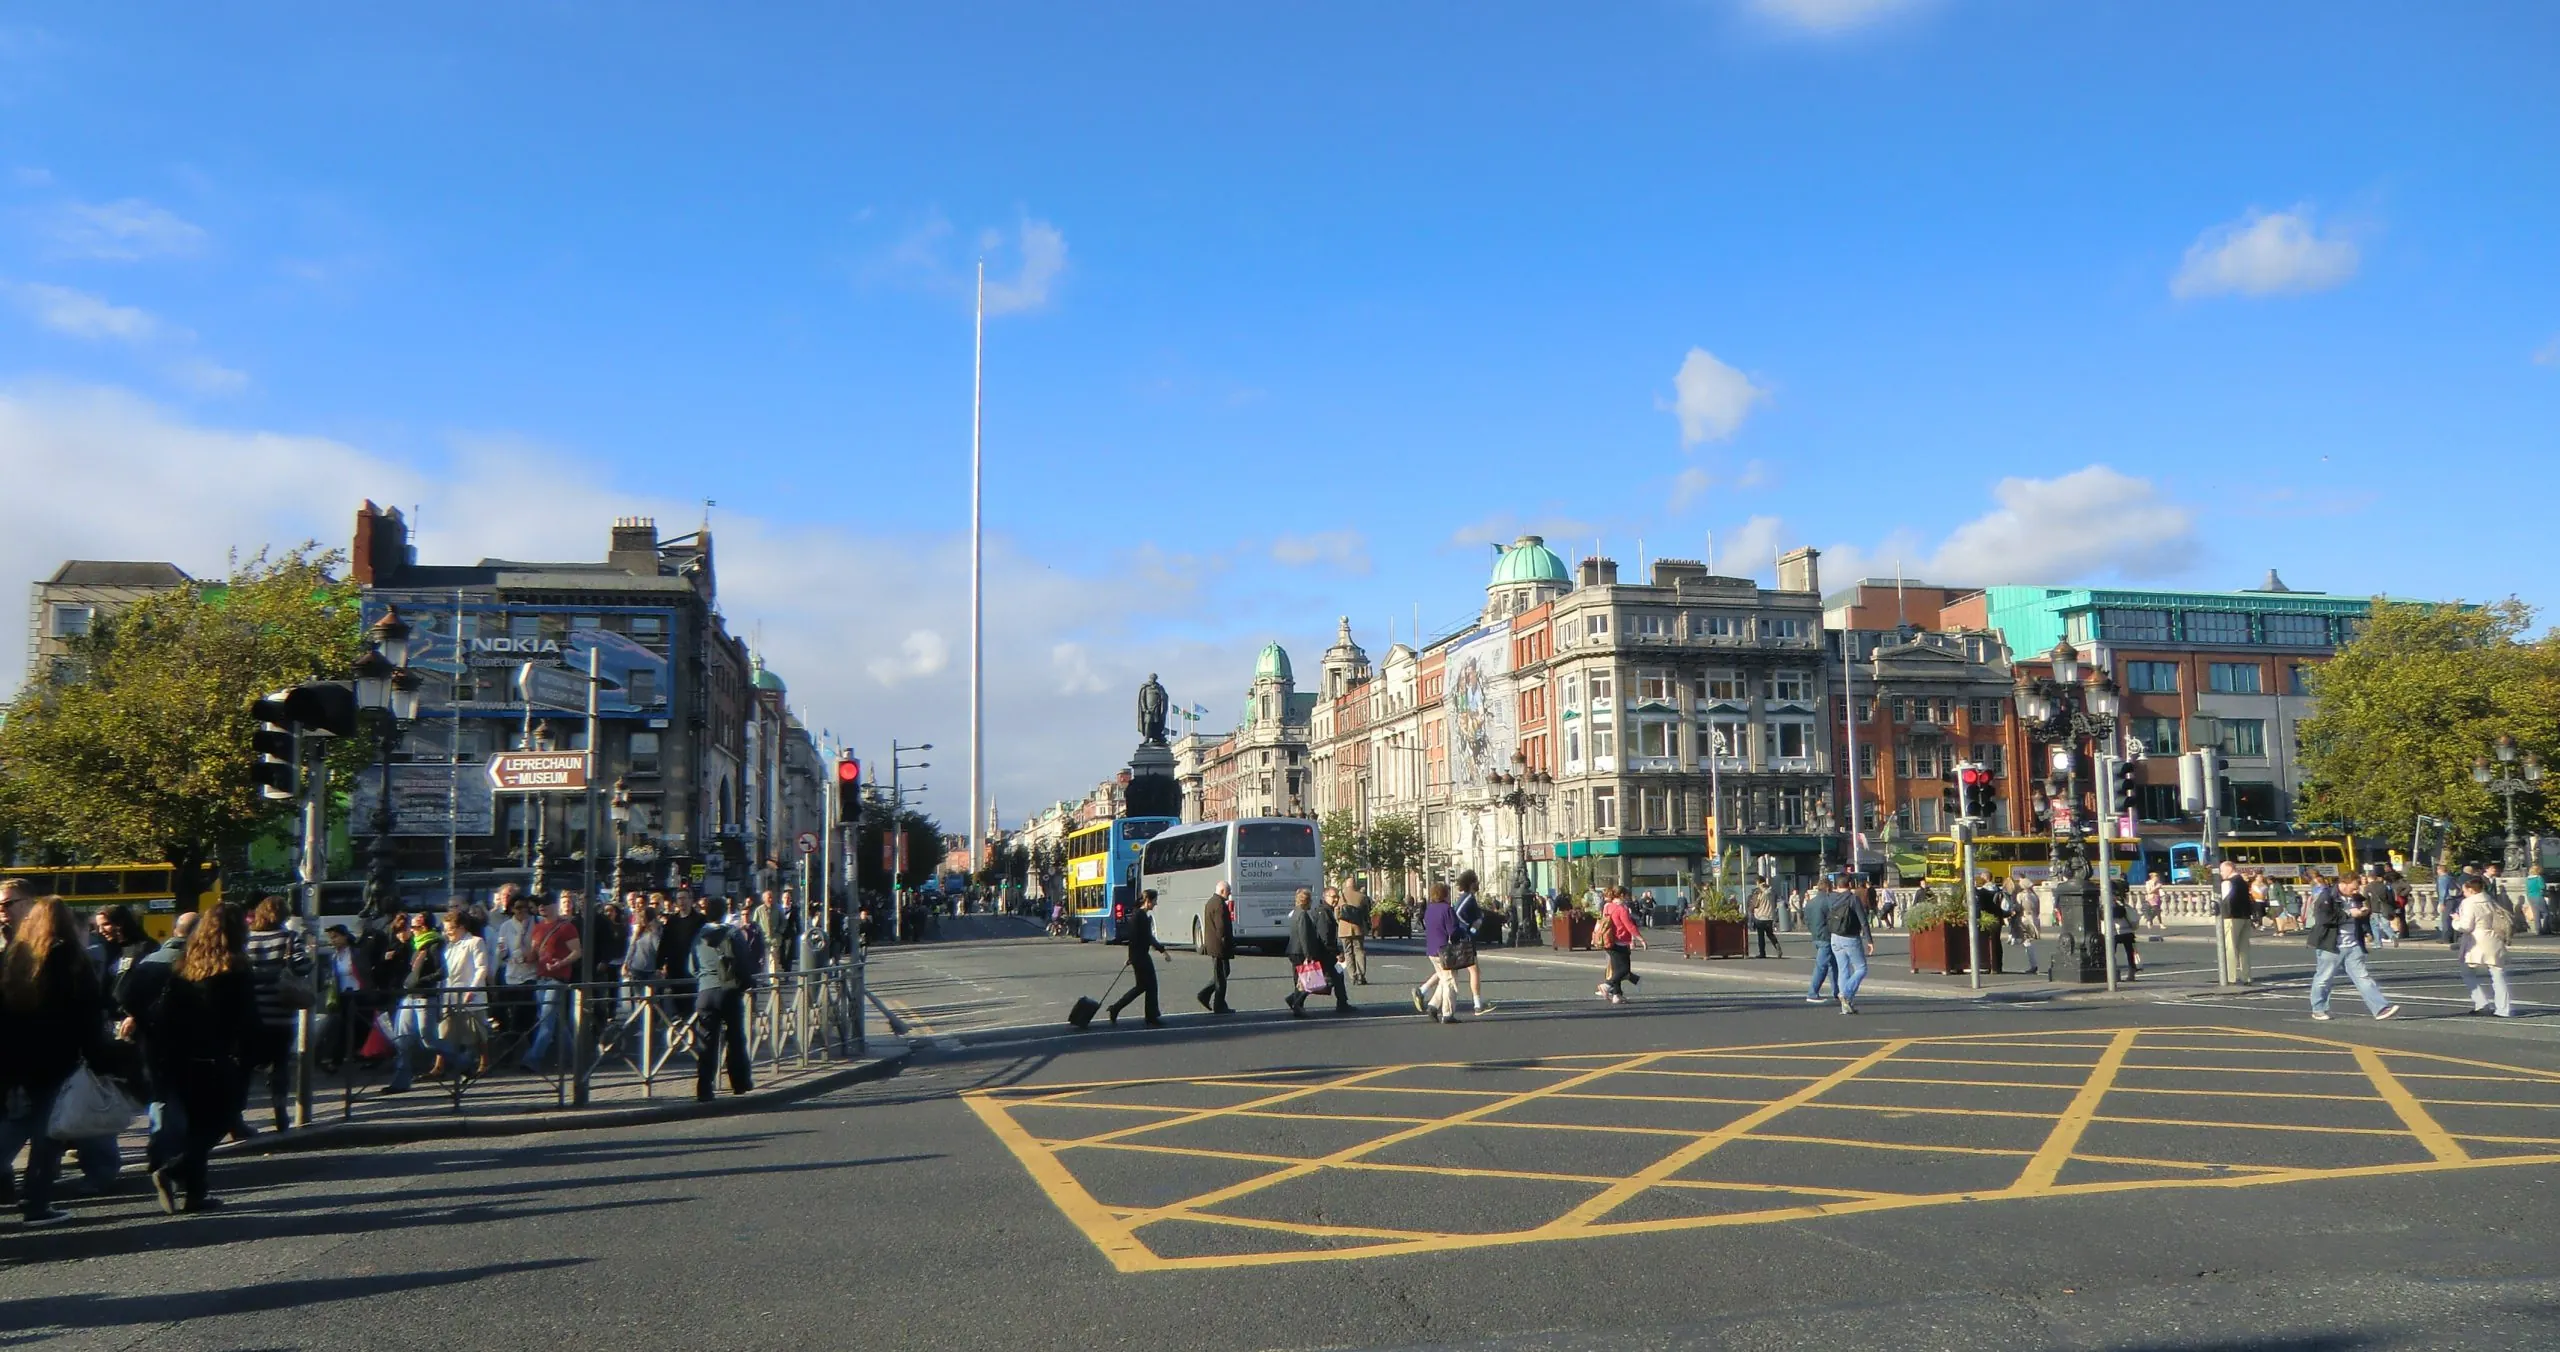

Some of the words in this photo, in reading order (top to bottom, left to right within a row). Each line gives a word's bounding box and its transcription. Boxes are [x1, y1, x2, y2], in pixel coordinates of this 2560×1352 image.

[472, 638, 560, 652] NOKIA
[531, 656, 561, 668] eople
[506, 757, 582, 771] LEPRECHAUN
[519, 771, 568, 785] MUSEUM
[1240, 859, 1273, 868] Enfield
